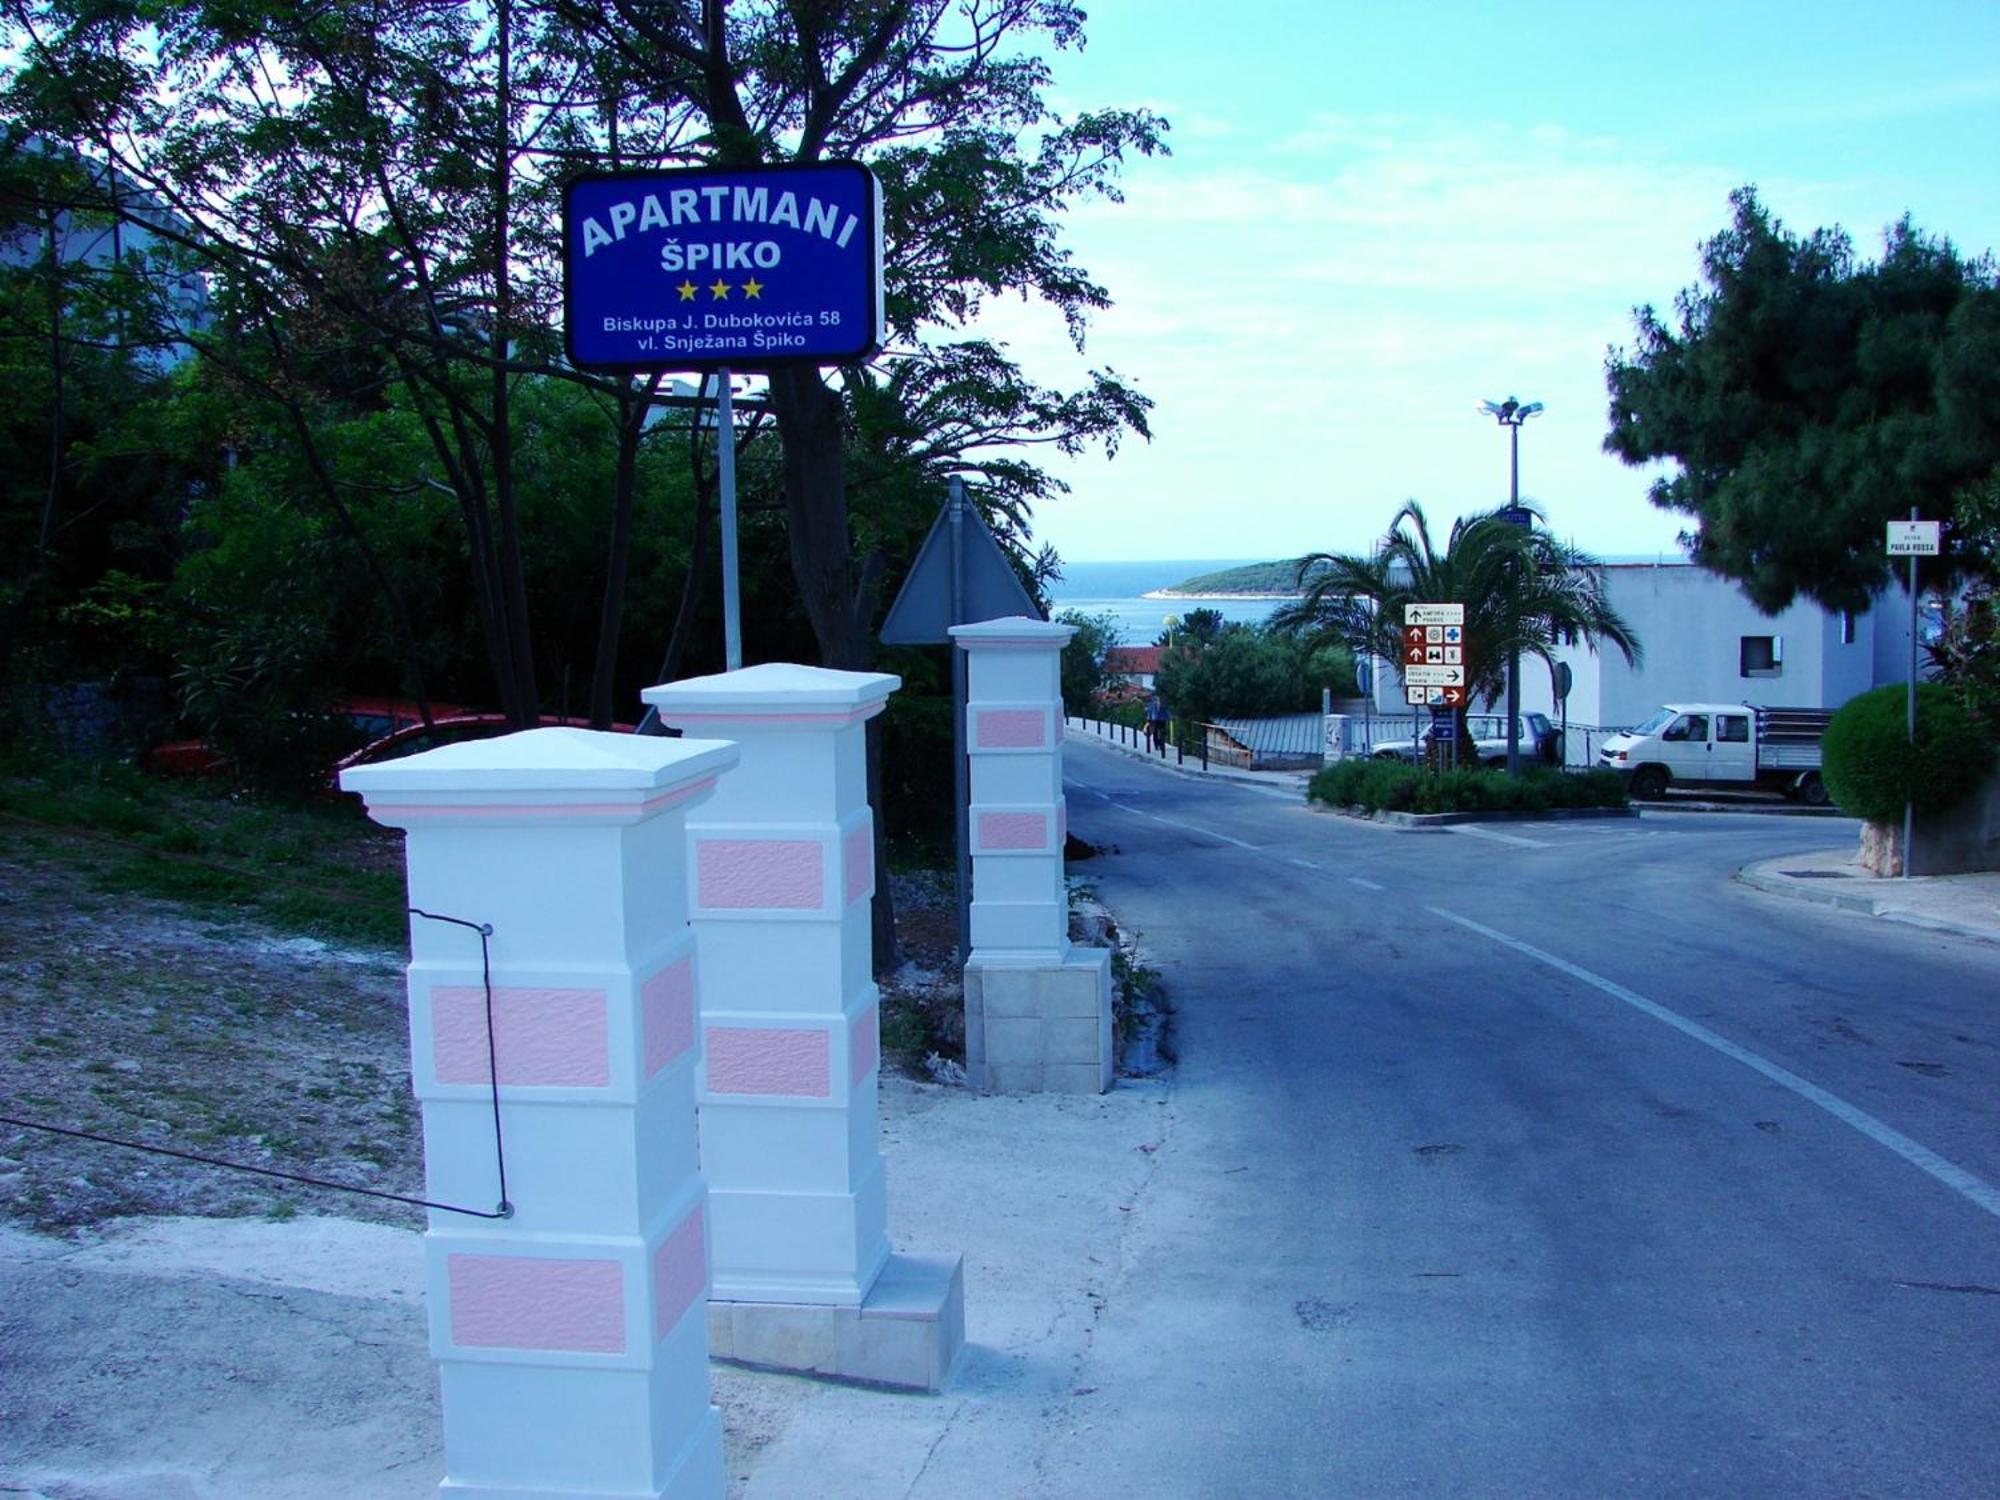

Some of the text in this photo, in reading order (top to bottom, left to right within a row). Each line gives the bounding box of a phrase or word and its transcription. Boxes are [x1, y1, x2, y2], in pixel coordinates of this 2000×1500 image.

[582, 186, 859, 258] APARTMANI
[660, 238, 781, 271] ŠPIKO
[603, 310, 841, 333] Biskupa J. Dubokovića 58
[637, 329, 806, 352] vl. Snježana Špiko
